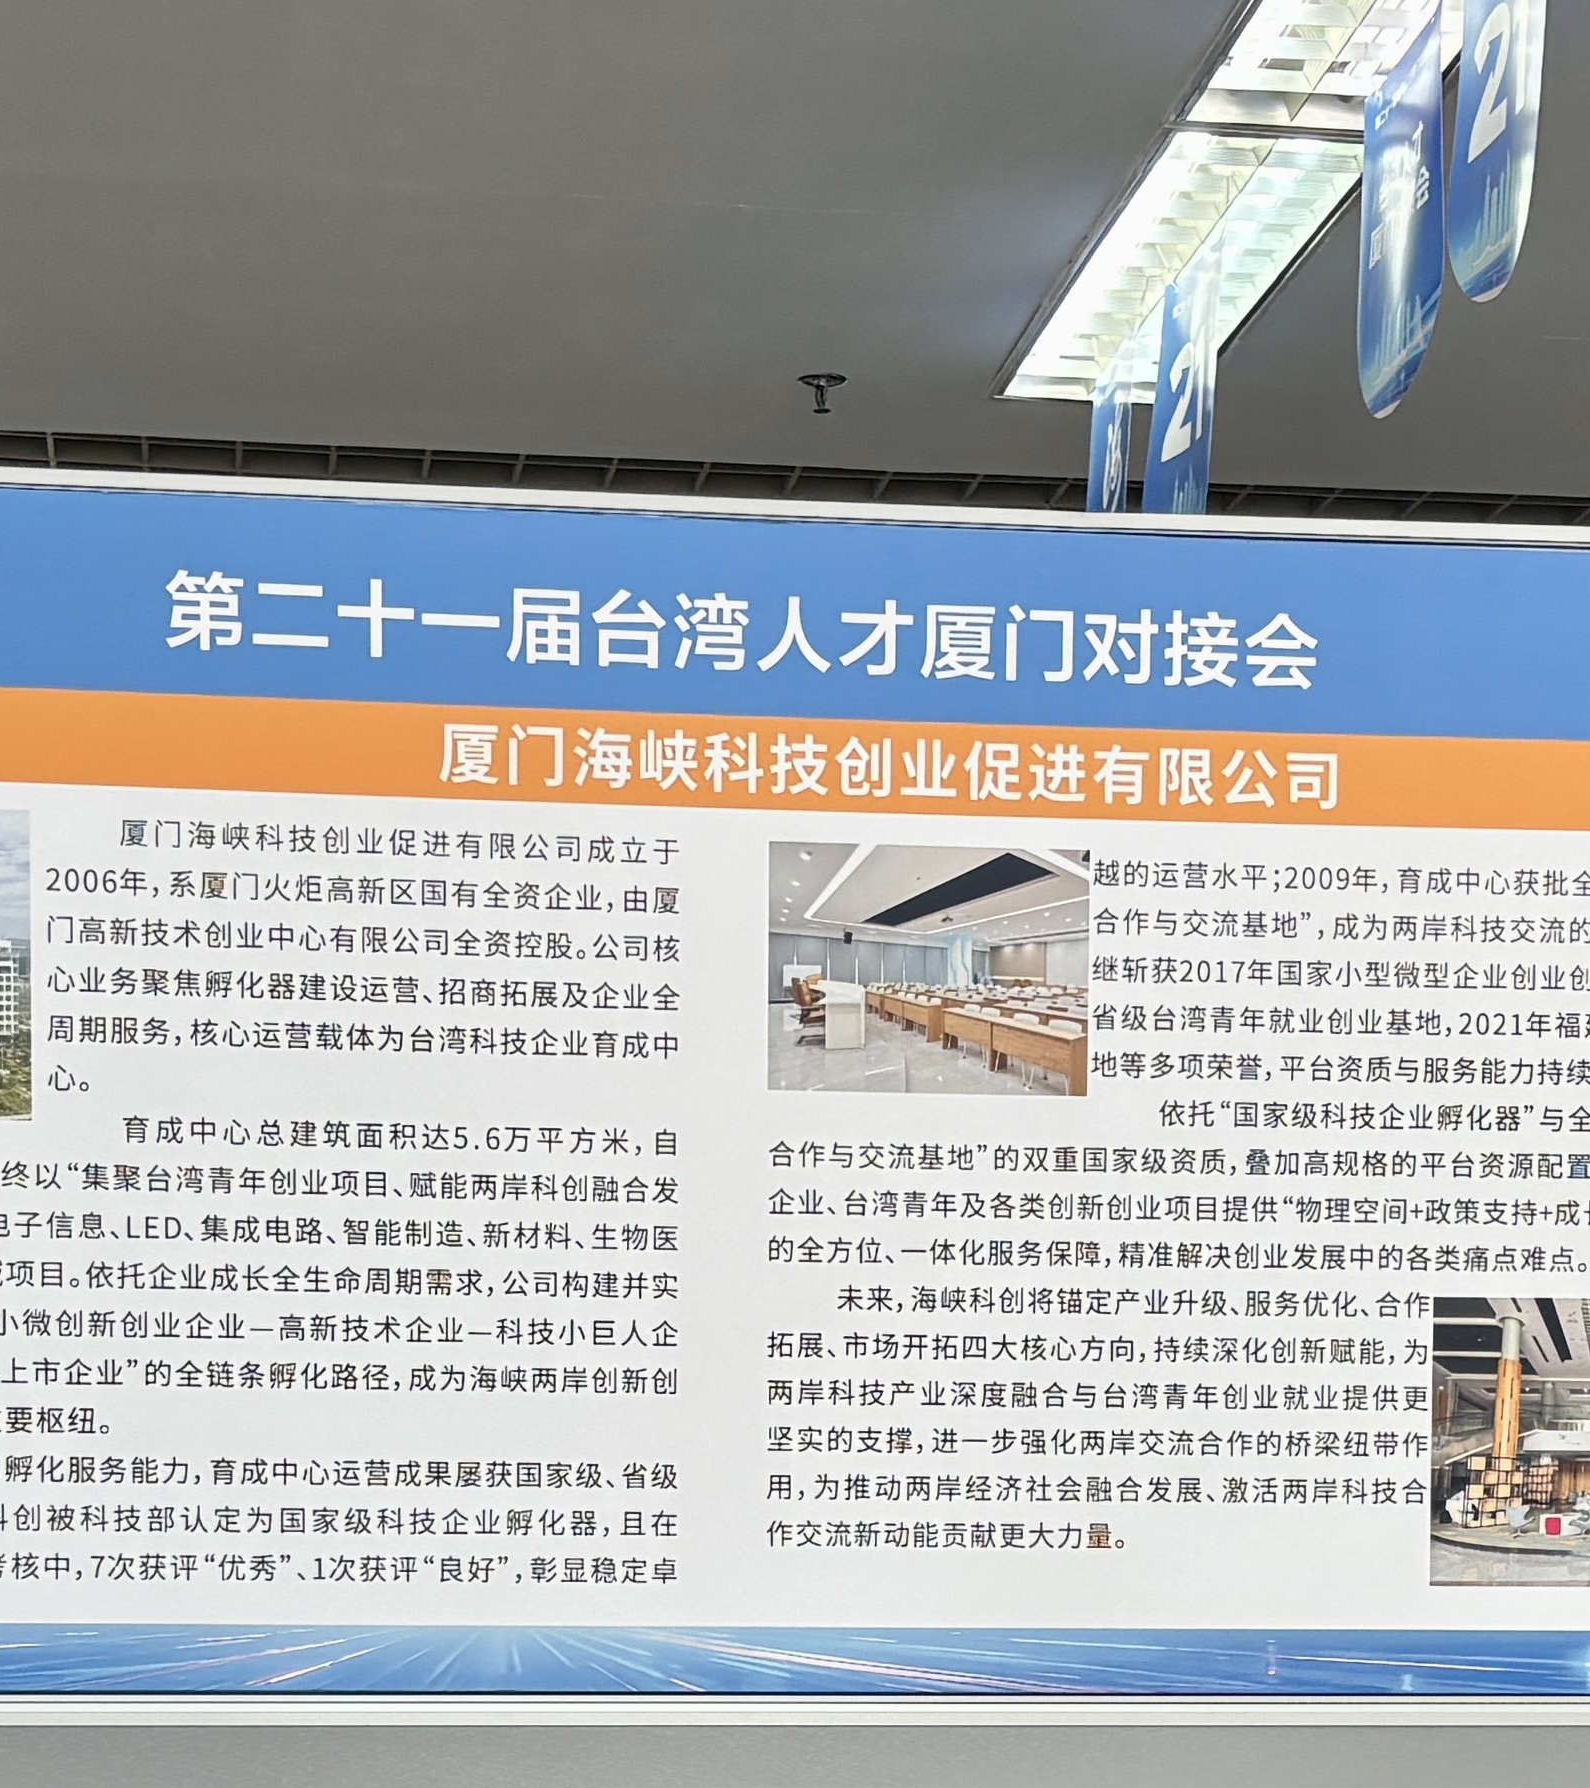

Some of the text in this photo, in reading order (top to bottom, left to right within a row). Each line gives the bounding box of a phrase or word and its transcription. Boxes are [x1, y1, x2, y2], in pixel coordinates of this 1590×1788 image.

[165, 569, 1320, 690] 第二十一届台湾人才厦门对接会
[437, 723, 1341, 810] 厦门海峡科技创业促进有限公司
[120, 820, 679, 865] 厦门海峡科技创业促进有限公司成立于
[48, 1065, 89, 1092] 心。
[767, 1520, 1124, 1549] 作交流新动能贡献更大力量。
